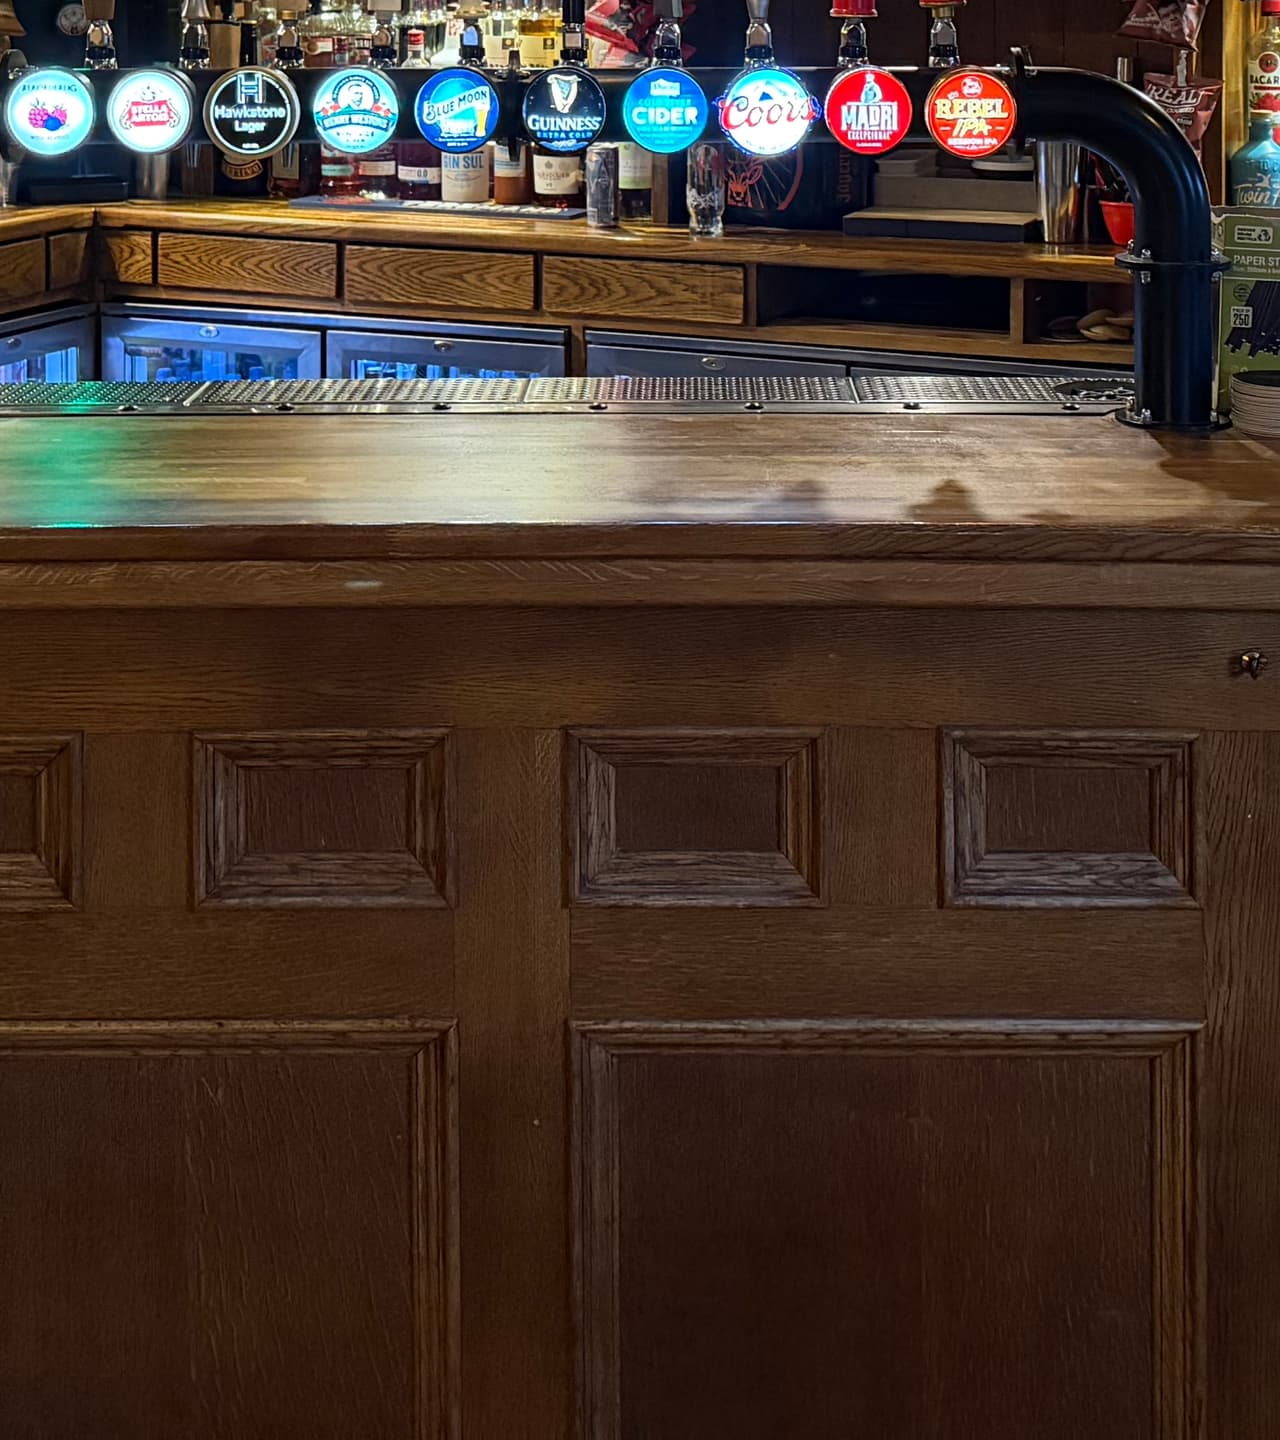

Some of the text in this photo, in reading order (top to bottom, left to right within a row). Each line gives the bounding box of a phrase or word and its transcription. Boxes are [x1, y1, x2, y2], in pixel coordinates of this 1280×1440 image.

[131, 104, 169, 114] STELLA
[214, 104, 286, 119] Hawkstone
[426, 89, 489, 122] BLUE MOON
[715, 95, 818, 130] Coors
[934, 98, 1009, 120] REBEL
[131, 112, 169, 122] ARTOIS
[528, 114, 602, 131] GUINNESS
[631, 106, 699, 126] CIDER
[234, 120, 266, 134] Lager
[536, 131, 565, 139] EXTRA
[952, 118, 993, 138] IPA
[444, 154, 485, 170] GIN SUL
[1233, 184, 1270, 205] Twin
[1233, 254, 1268, 267] PAPER
[1233, 313, 1250, 326] 250
